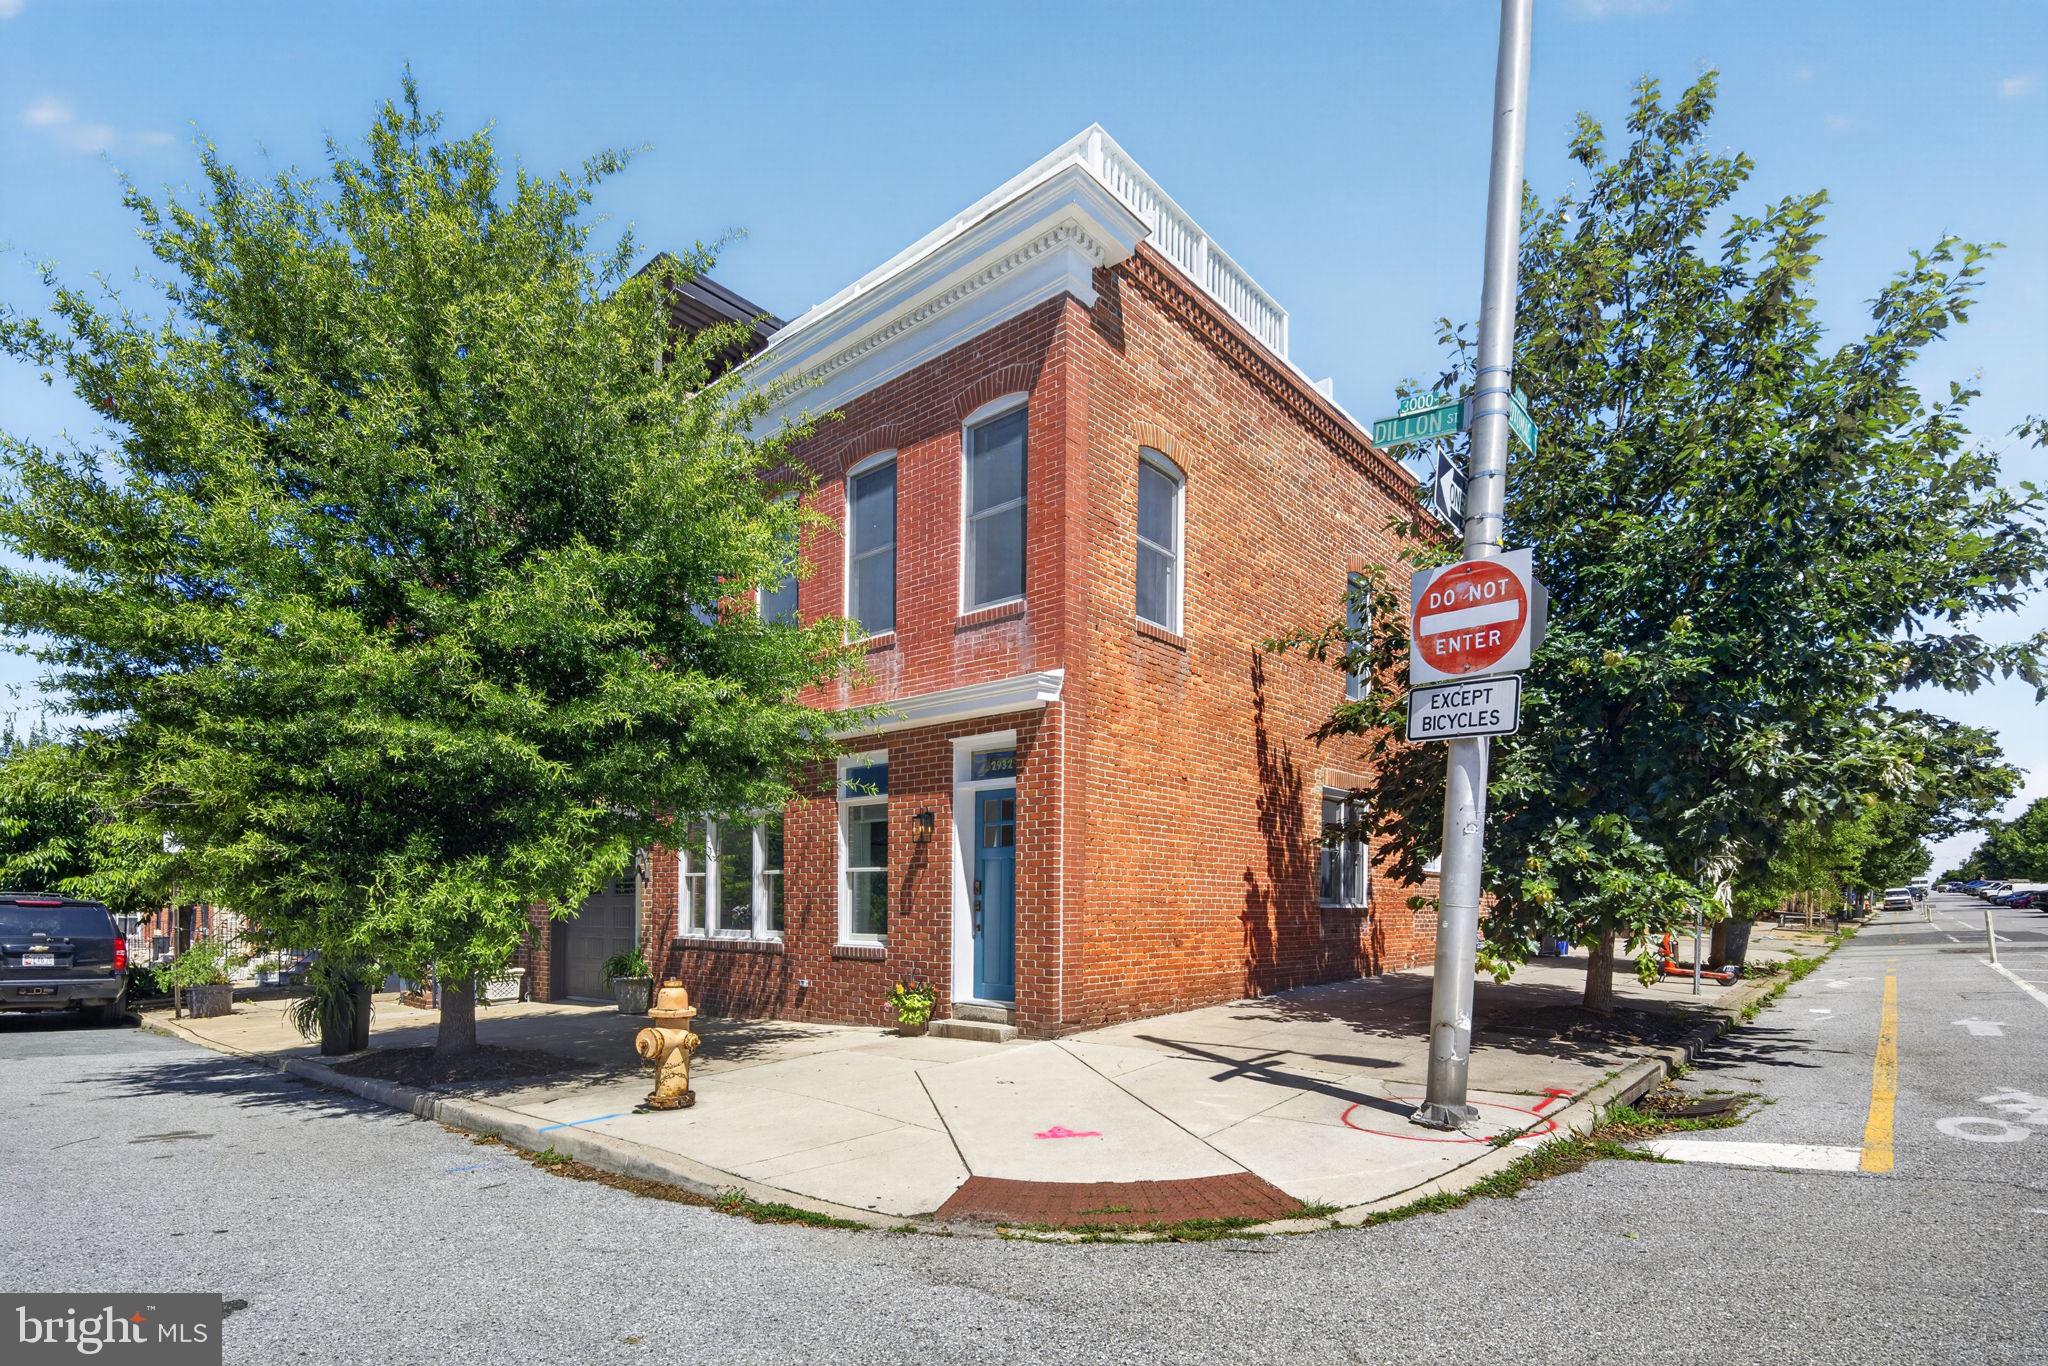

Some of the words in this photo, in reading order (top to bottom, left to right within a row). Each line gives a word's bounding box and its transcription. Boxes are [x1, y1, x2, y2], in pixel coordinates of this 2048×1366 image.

[1375, 413, 1441, 443] DILLON
[1447, 412, 1458, 424] ST
[1450, 483, 1466, 516] ON
[1430, 590, 1454, 609] DO
[1469, 578, 1509, 602] NOT
[1435, 630, 1500, 656] ENTER
[1431, 688, 1493, 710] EXCEPT
[1422, 709, 1500, 732] BICYCLES
[991, 759, 1013, 771] 2932
